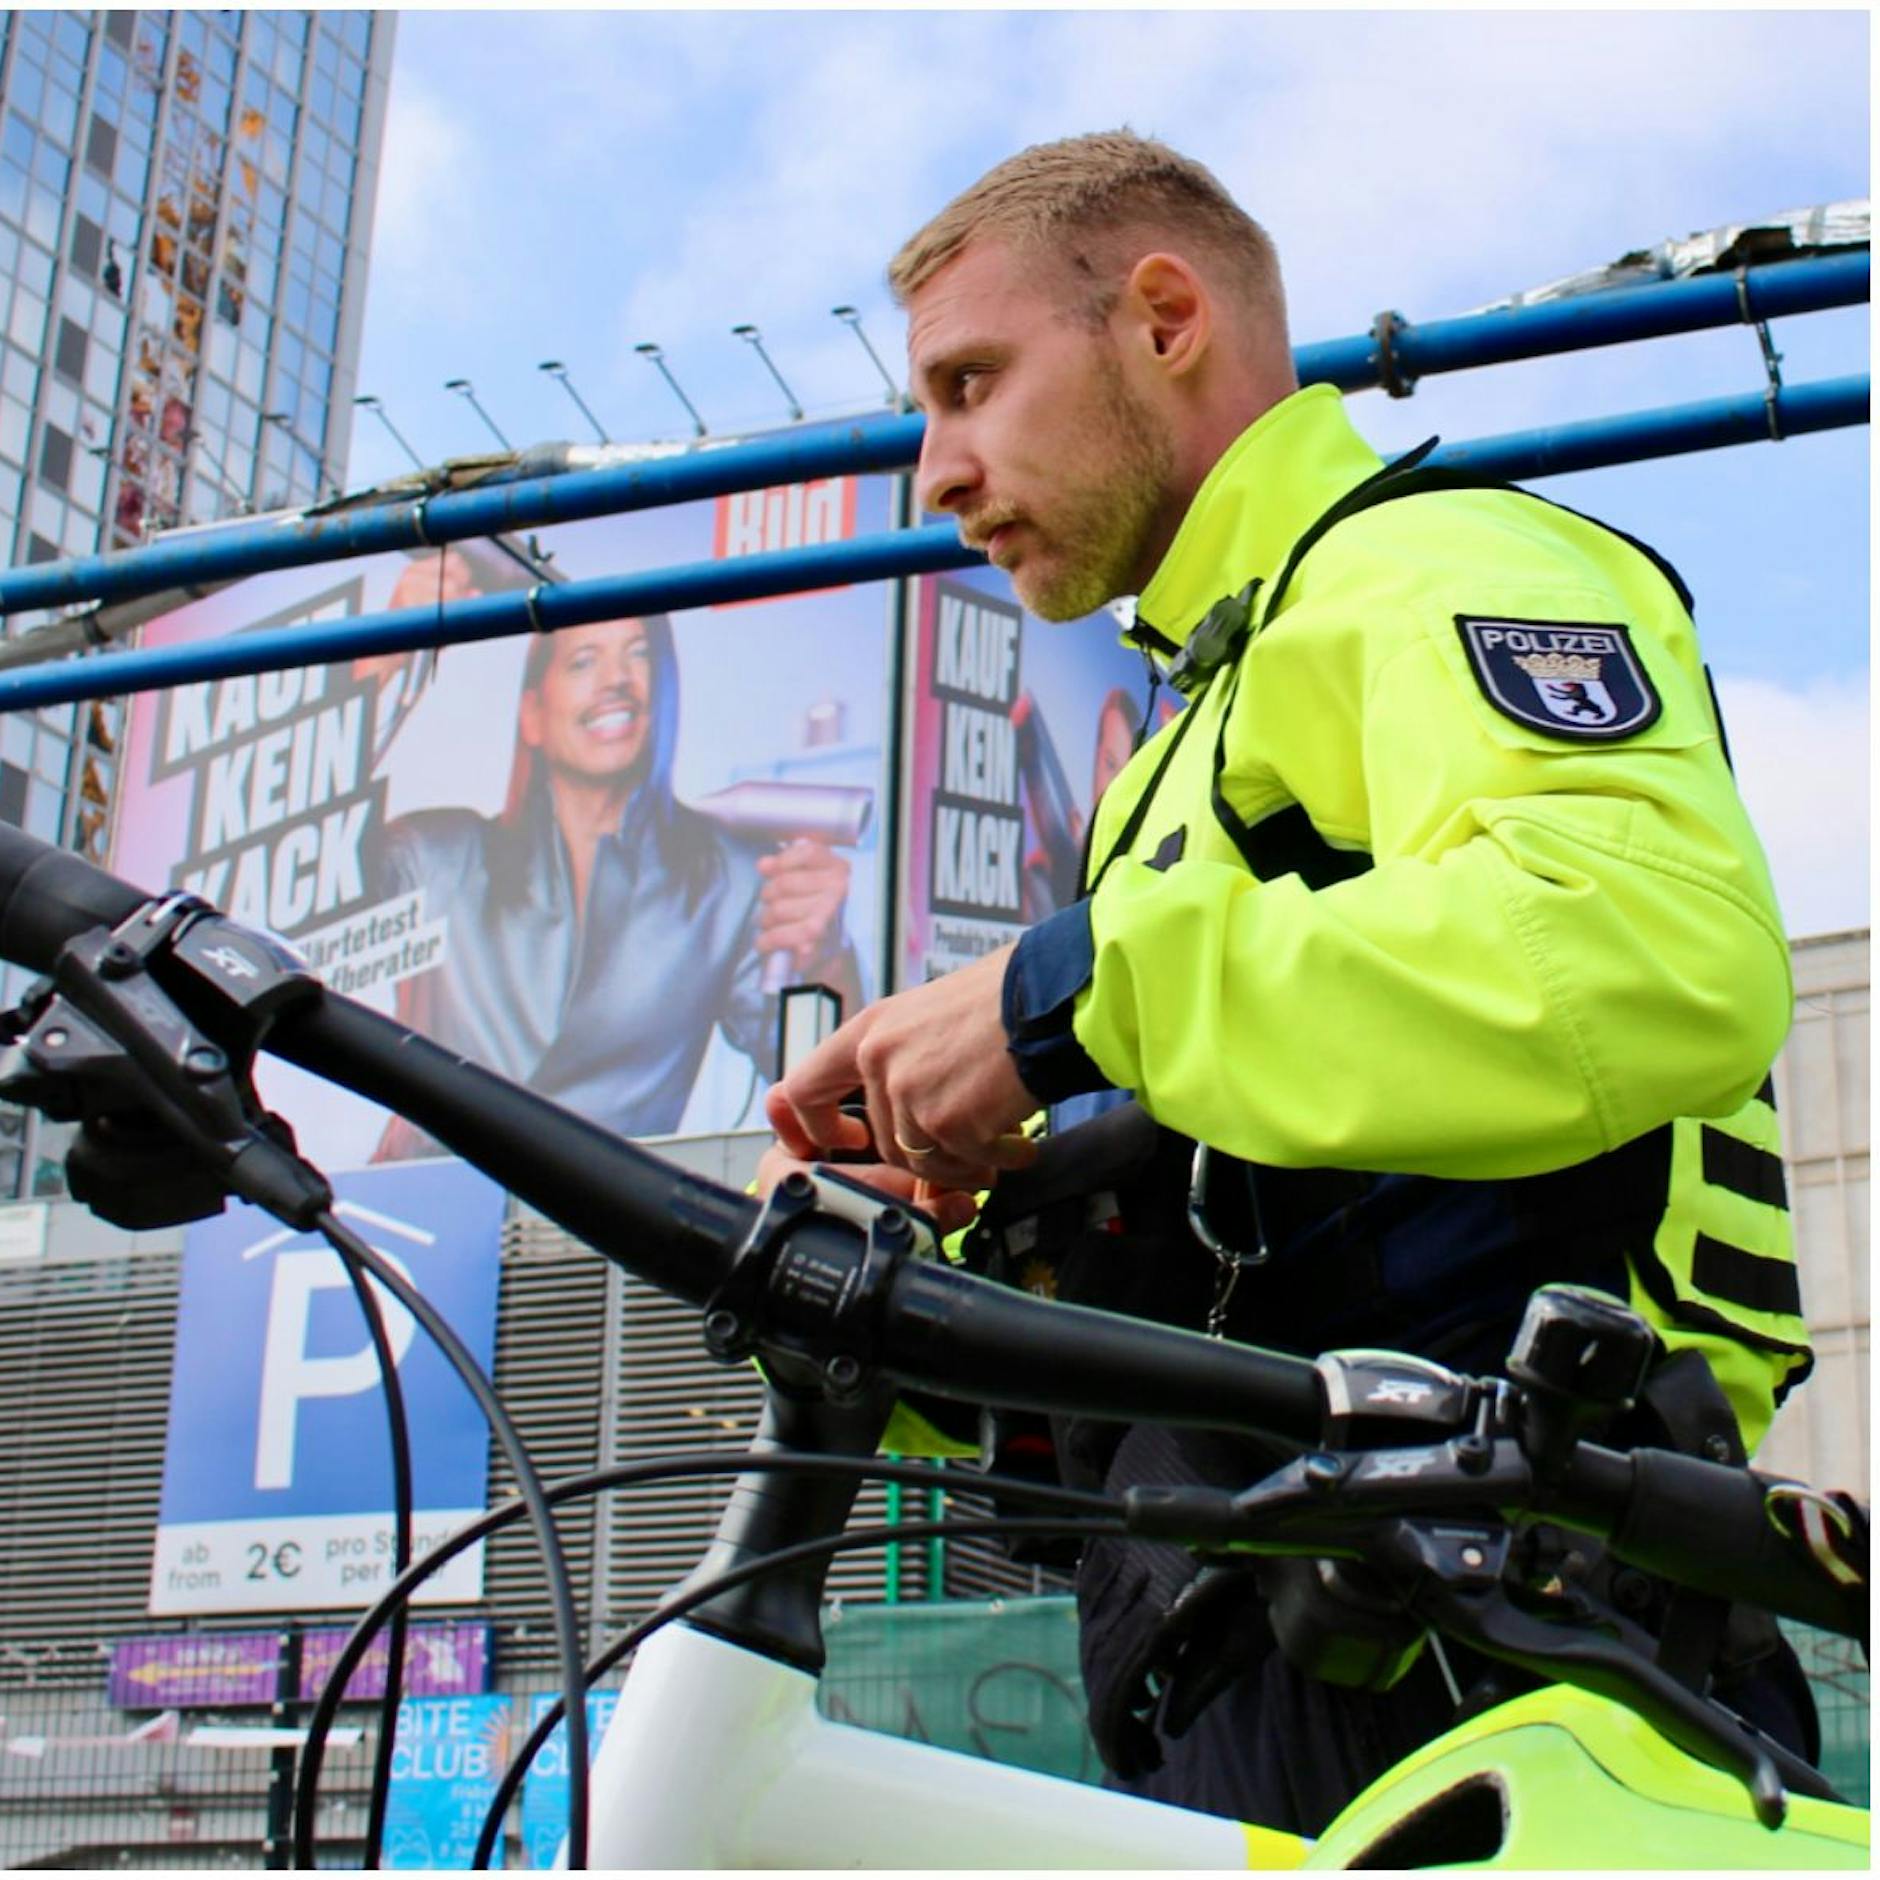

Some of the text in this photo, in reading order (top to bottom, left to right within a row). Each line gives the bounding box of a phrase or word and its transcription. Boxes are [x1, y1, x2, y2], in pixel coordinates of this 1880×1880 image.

[937, 594, 1019, 704] KAUF
[1480, 629, 1616, 654] POLIZEI
[202, 696, 362, 855] KEIN
[944, 703, 1018, 806] KEIN
[934, 806, 1021, 909] KACK
[255, 1245, 418, 1488] P
[168, 1569, 221, 1590] from
[341, 1563, 379, 1586] per
[181, 1541, 209, 1565] ab
[246, 1542, 303, 1579] 2€
[326, 1537, 368, 1561] pro
[396, 1702, 471, 1737] BITE
[391, 1743, 487, 1779] CLUB
